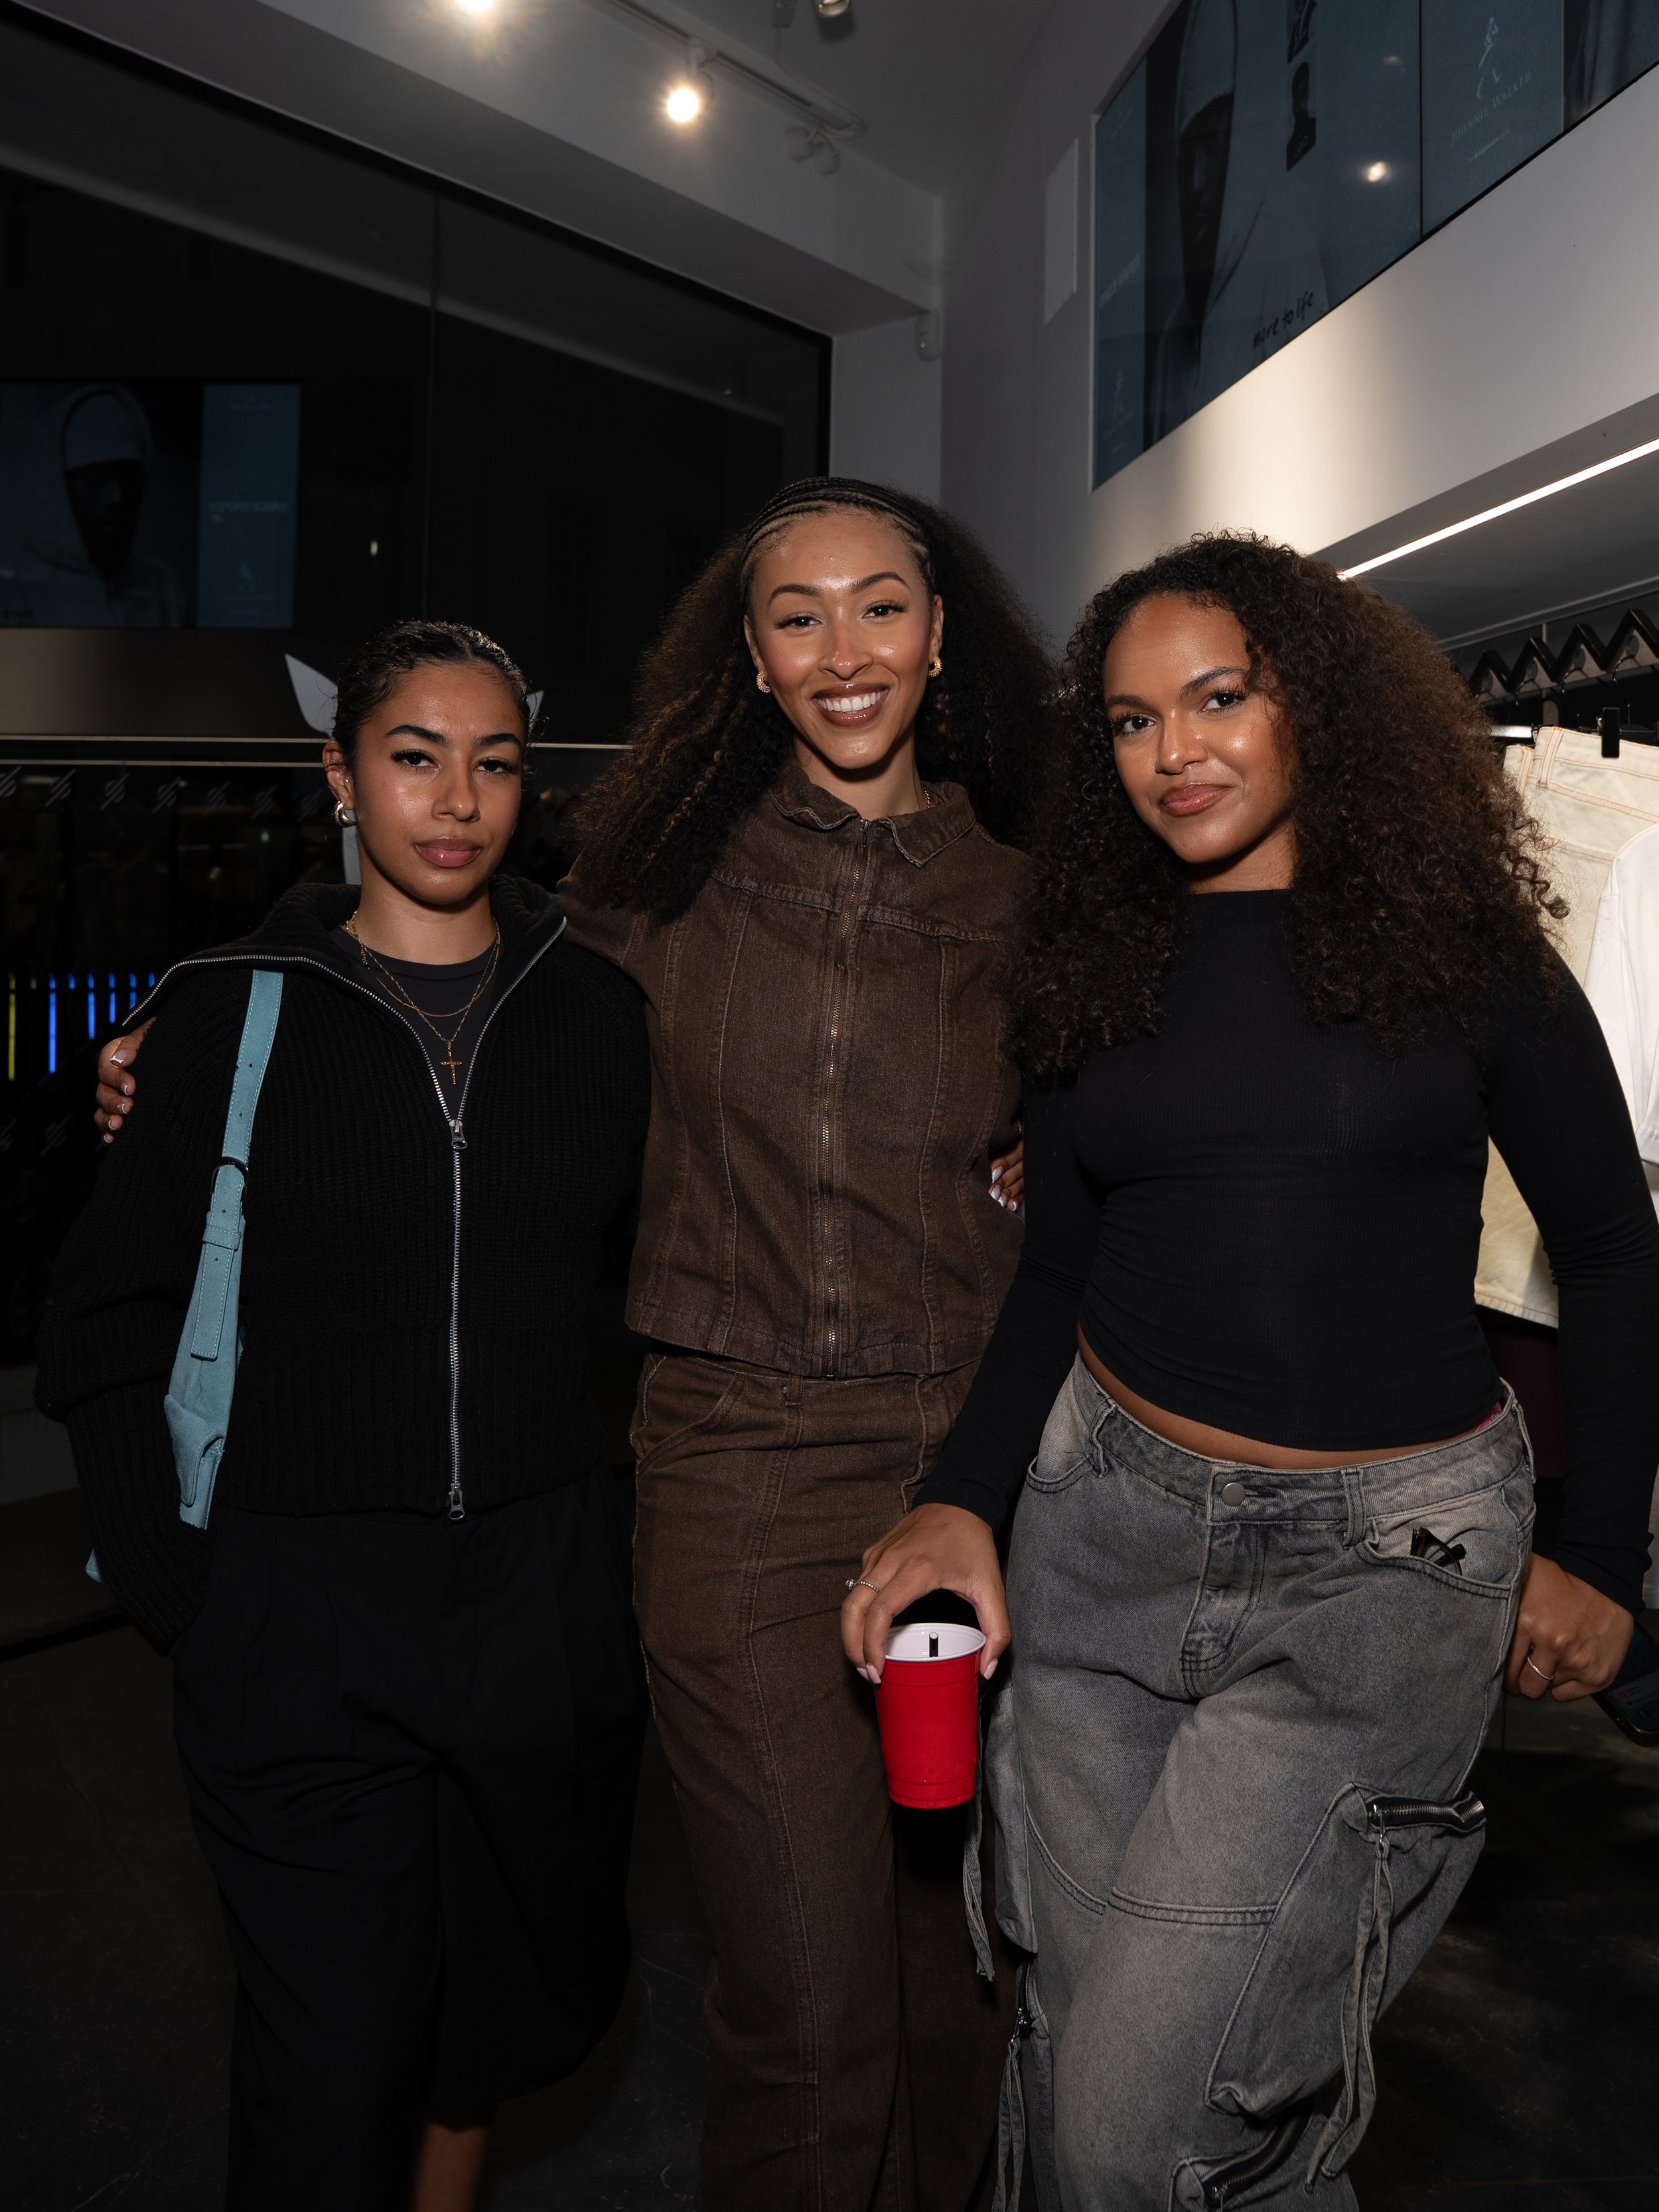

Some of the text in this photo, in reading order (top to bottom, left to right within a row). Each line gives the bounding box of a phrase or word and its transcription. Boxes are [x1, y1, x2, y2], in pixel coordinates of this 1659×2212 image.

[1449, 107, 1488, 149] JOHNNIE
[1492, 71, 1531, 109] WALKER
[1252, 291, 1314, 349] more to life
